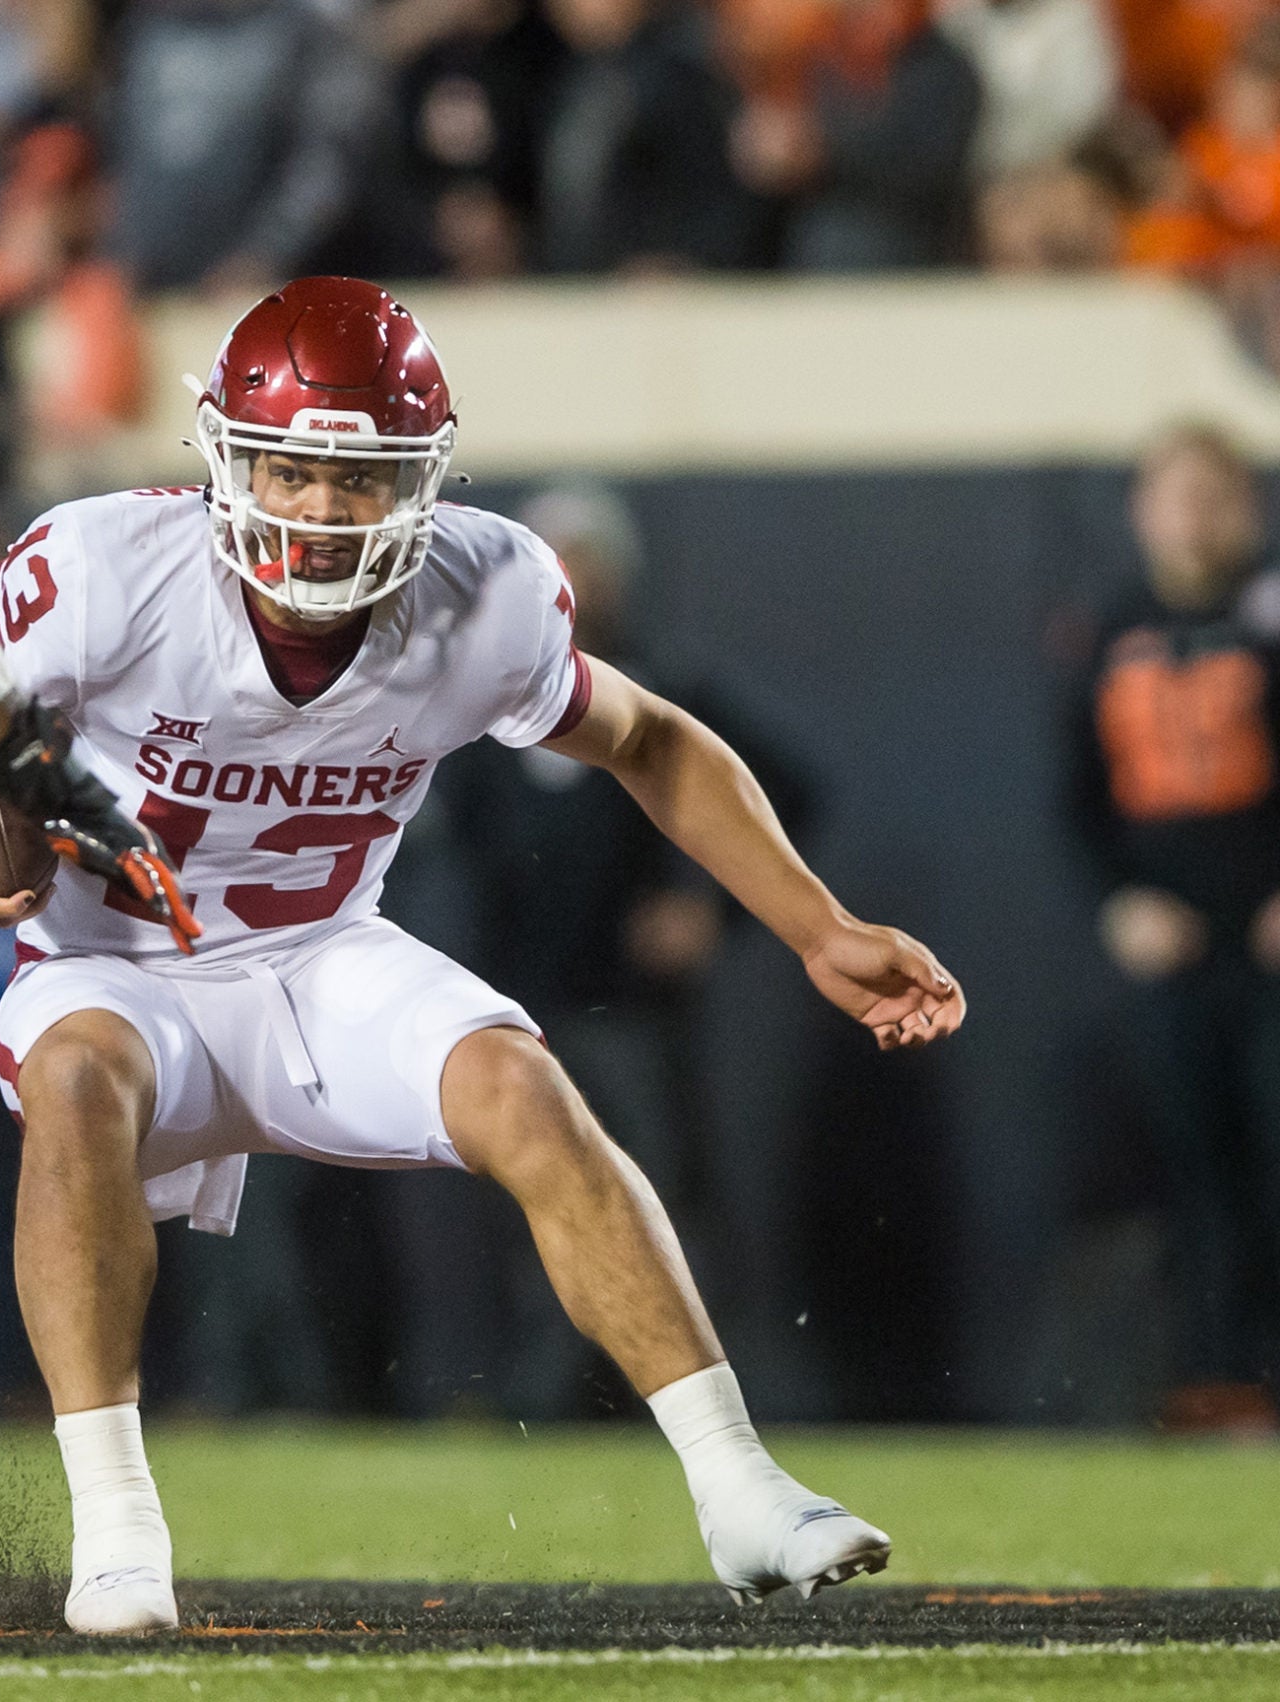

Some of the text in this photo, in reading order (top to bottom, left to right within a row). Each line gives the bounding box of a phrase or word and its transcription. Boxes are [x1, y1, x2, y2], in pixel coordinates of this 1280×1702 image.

[308, 418, 360, 433] OKLAHOMA
[147, 712, 205, 745] XII
[135, 744, 427, 807] SOONERS
